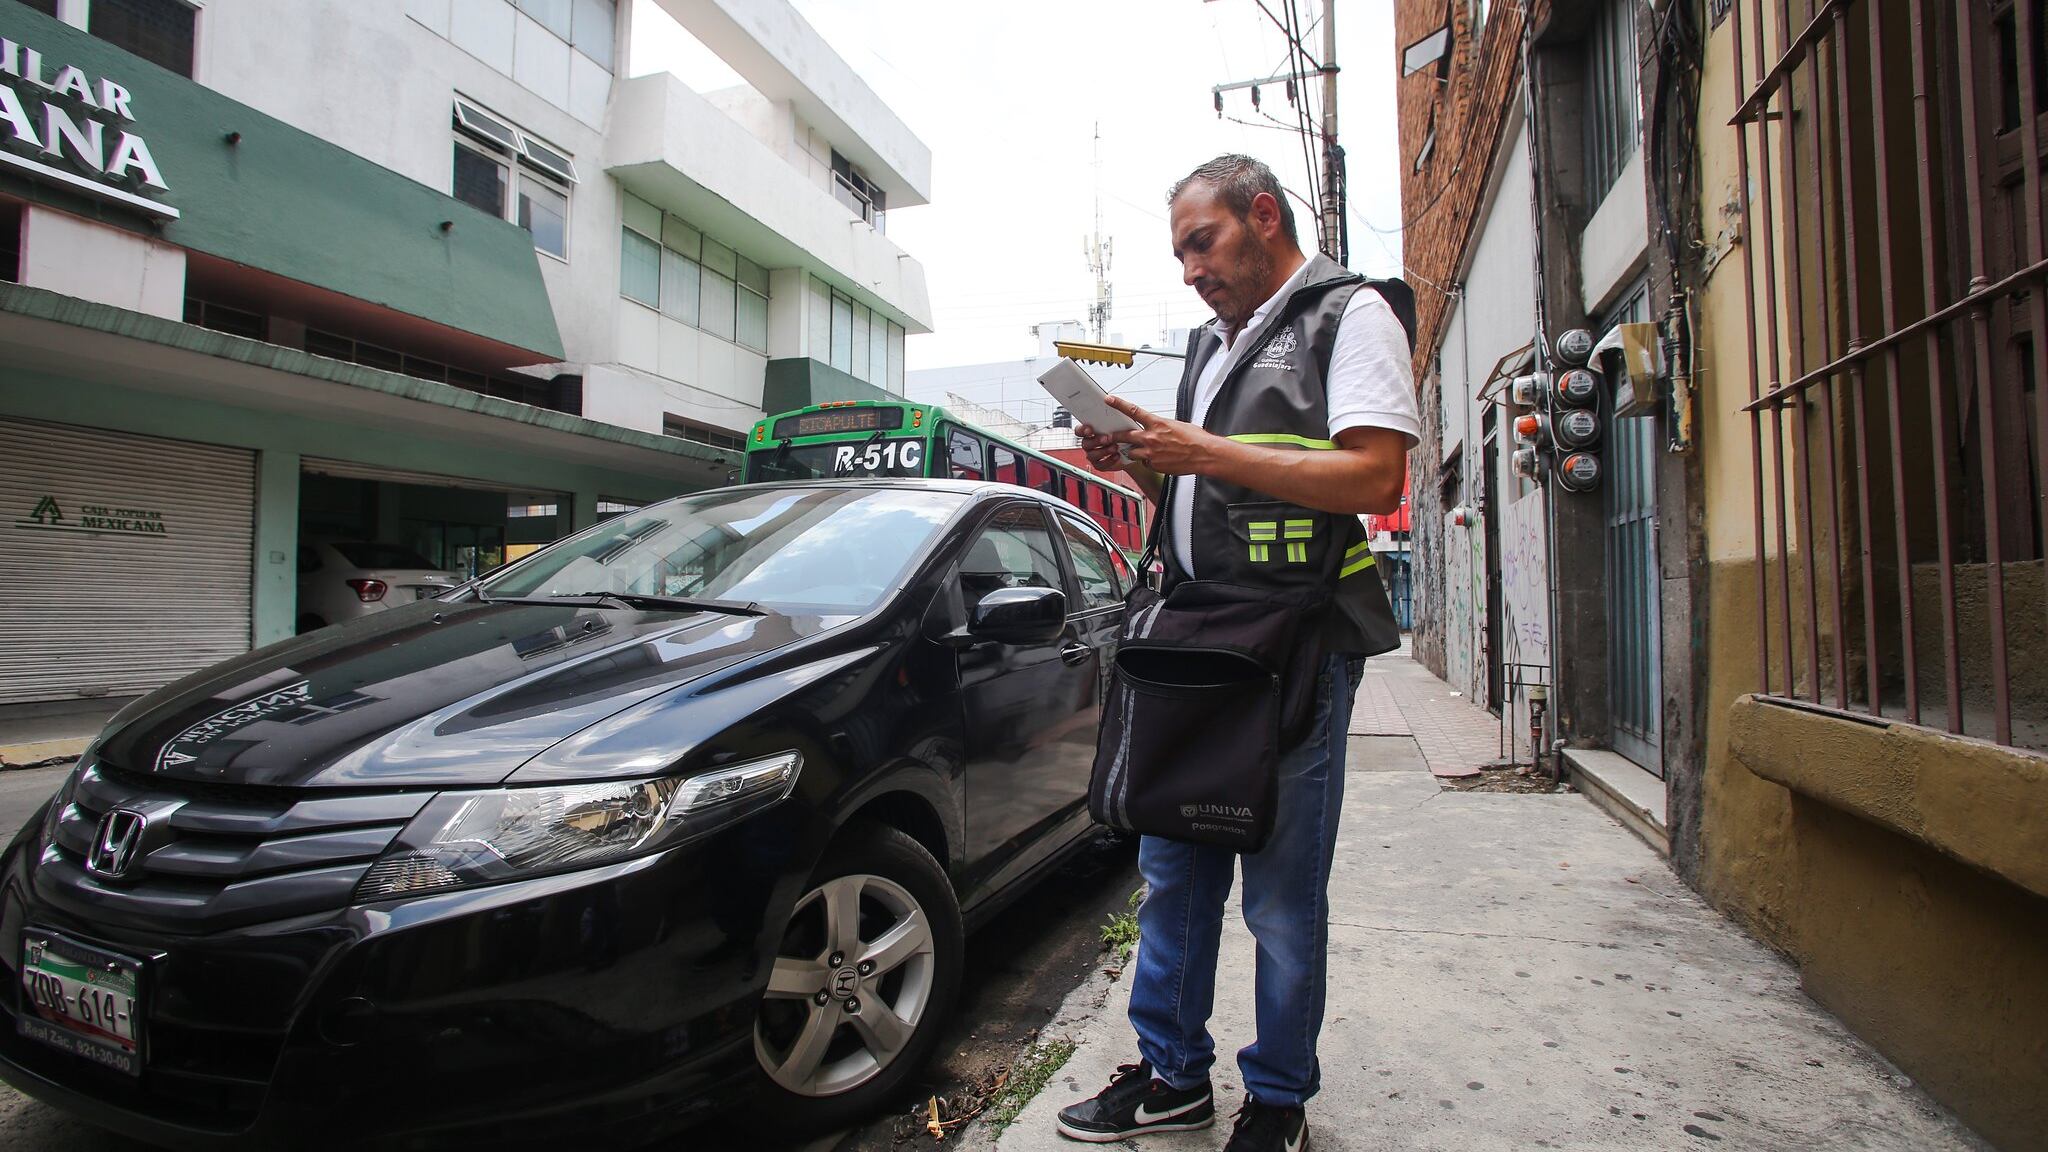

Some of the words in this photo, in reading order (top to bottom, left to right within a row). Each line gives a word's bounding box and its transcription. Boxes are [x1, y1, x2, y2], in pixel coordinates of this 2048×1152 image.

[1253, 362, 1292, 371] Guadalajara
[834, 441, 921, 472] R-51C
[115, 508, 161, 518] POPULAR
[81, 516, 166, 533] MEXICANA
[1199, 804, 1253, 817] UNIVA
[24, 1021, 48, 1041] Real
[77, 1039, 130, 1072] 921-30-00
